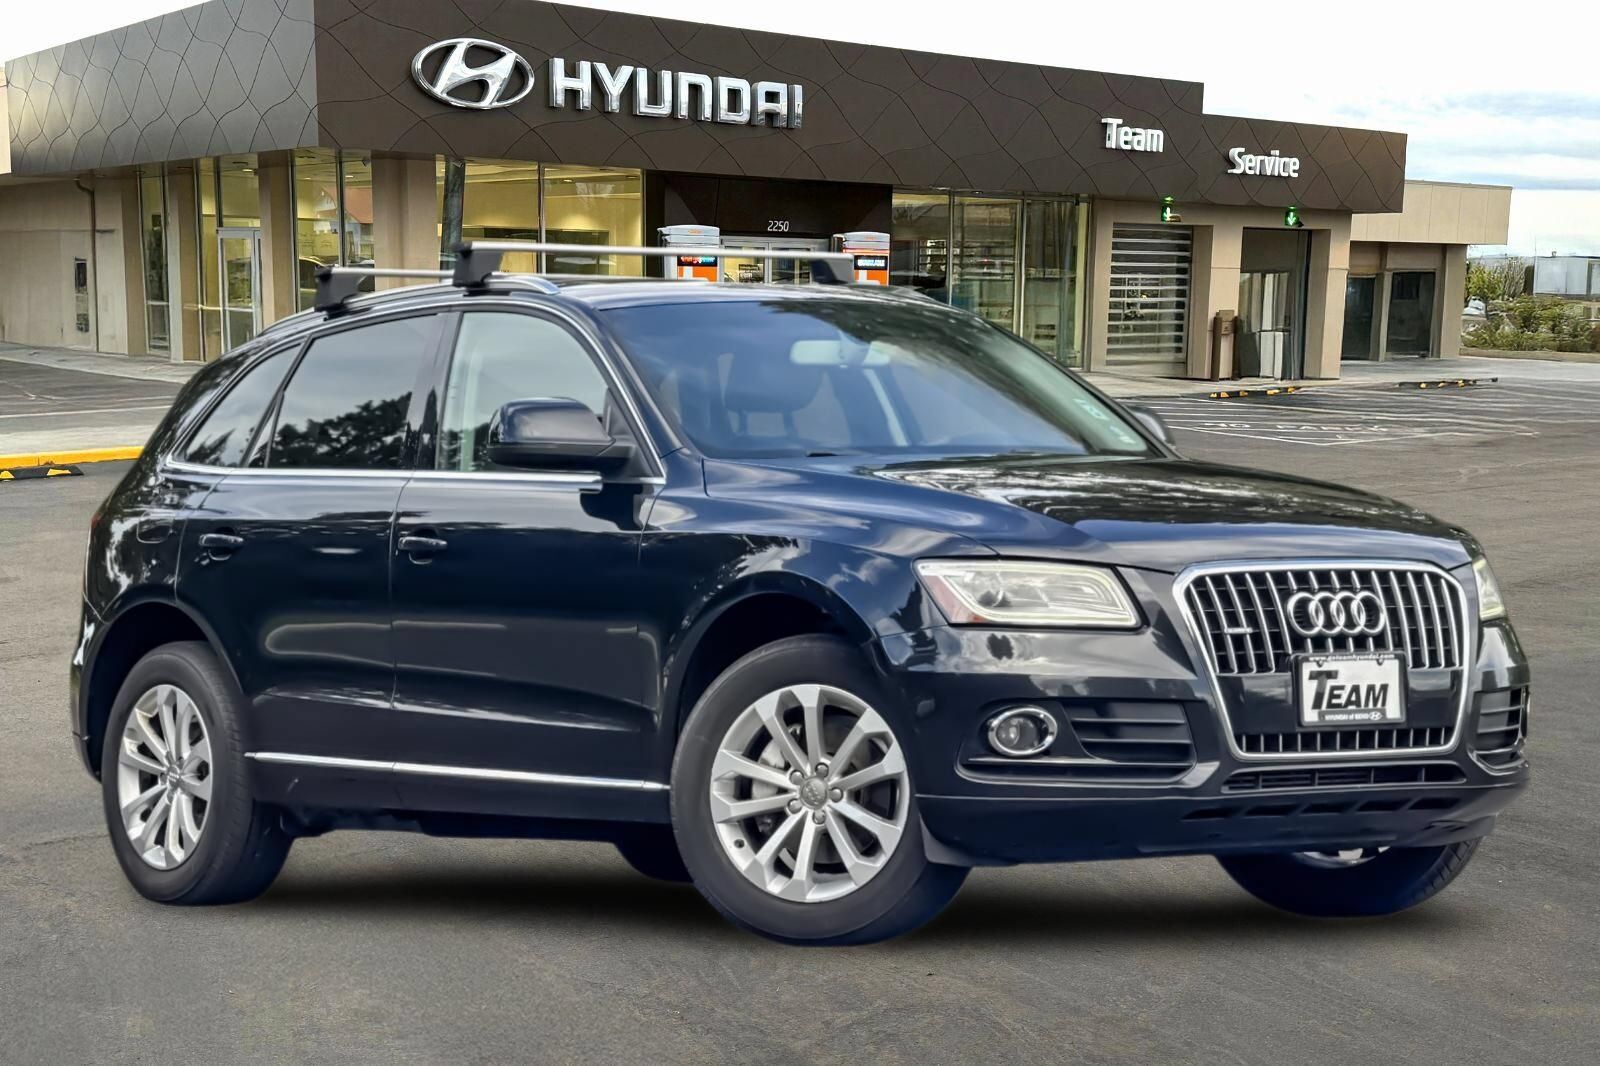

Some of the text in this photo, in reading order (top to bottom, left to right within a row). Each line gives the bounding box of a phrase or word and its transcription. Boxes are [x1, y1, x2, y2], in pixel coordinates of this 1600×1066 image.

[549, 57, 803, 129] HYUNDAI
[1101, 117, 1164, 152] Team
[1227, 147, 1300, 178] Service
[767, 220, 790, 232] 2250
[1308, 670, 1389, 710] TEAM
